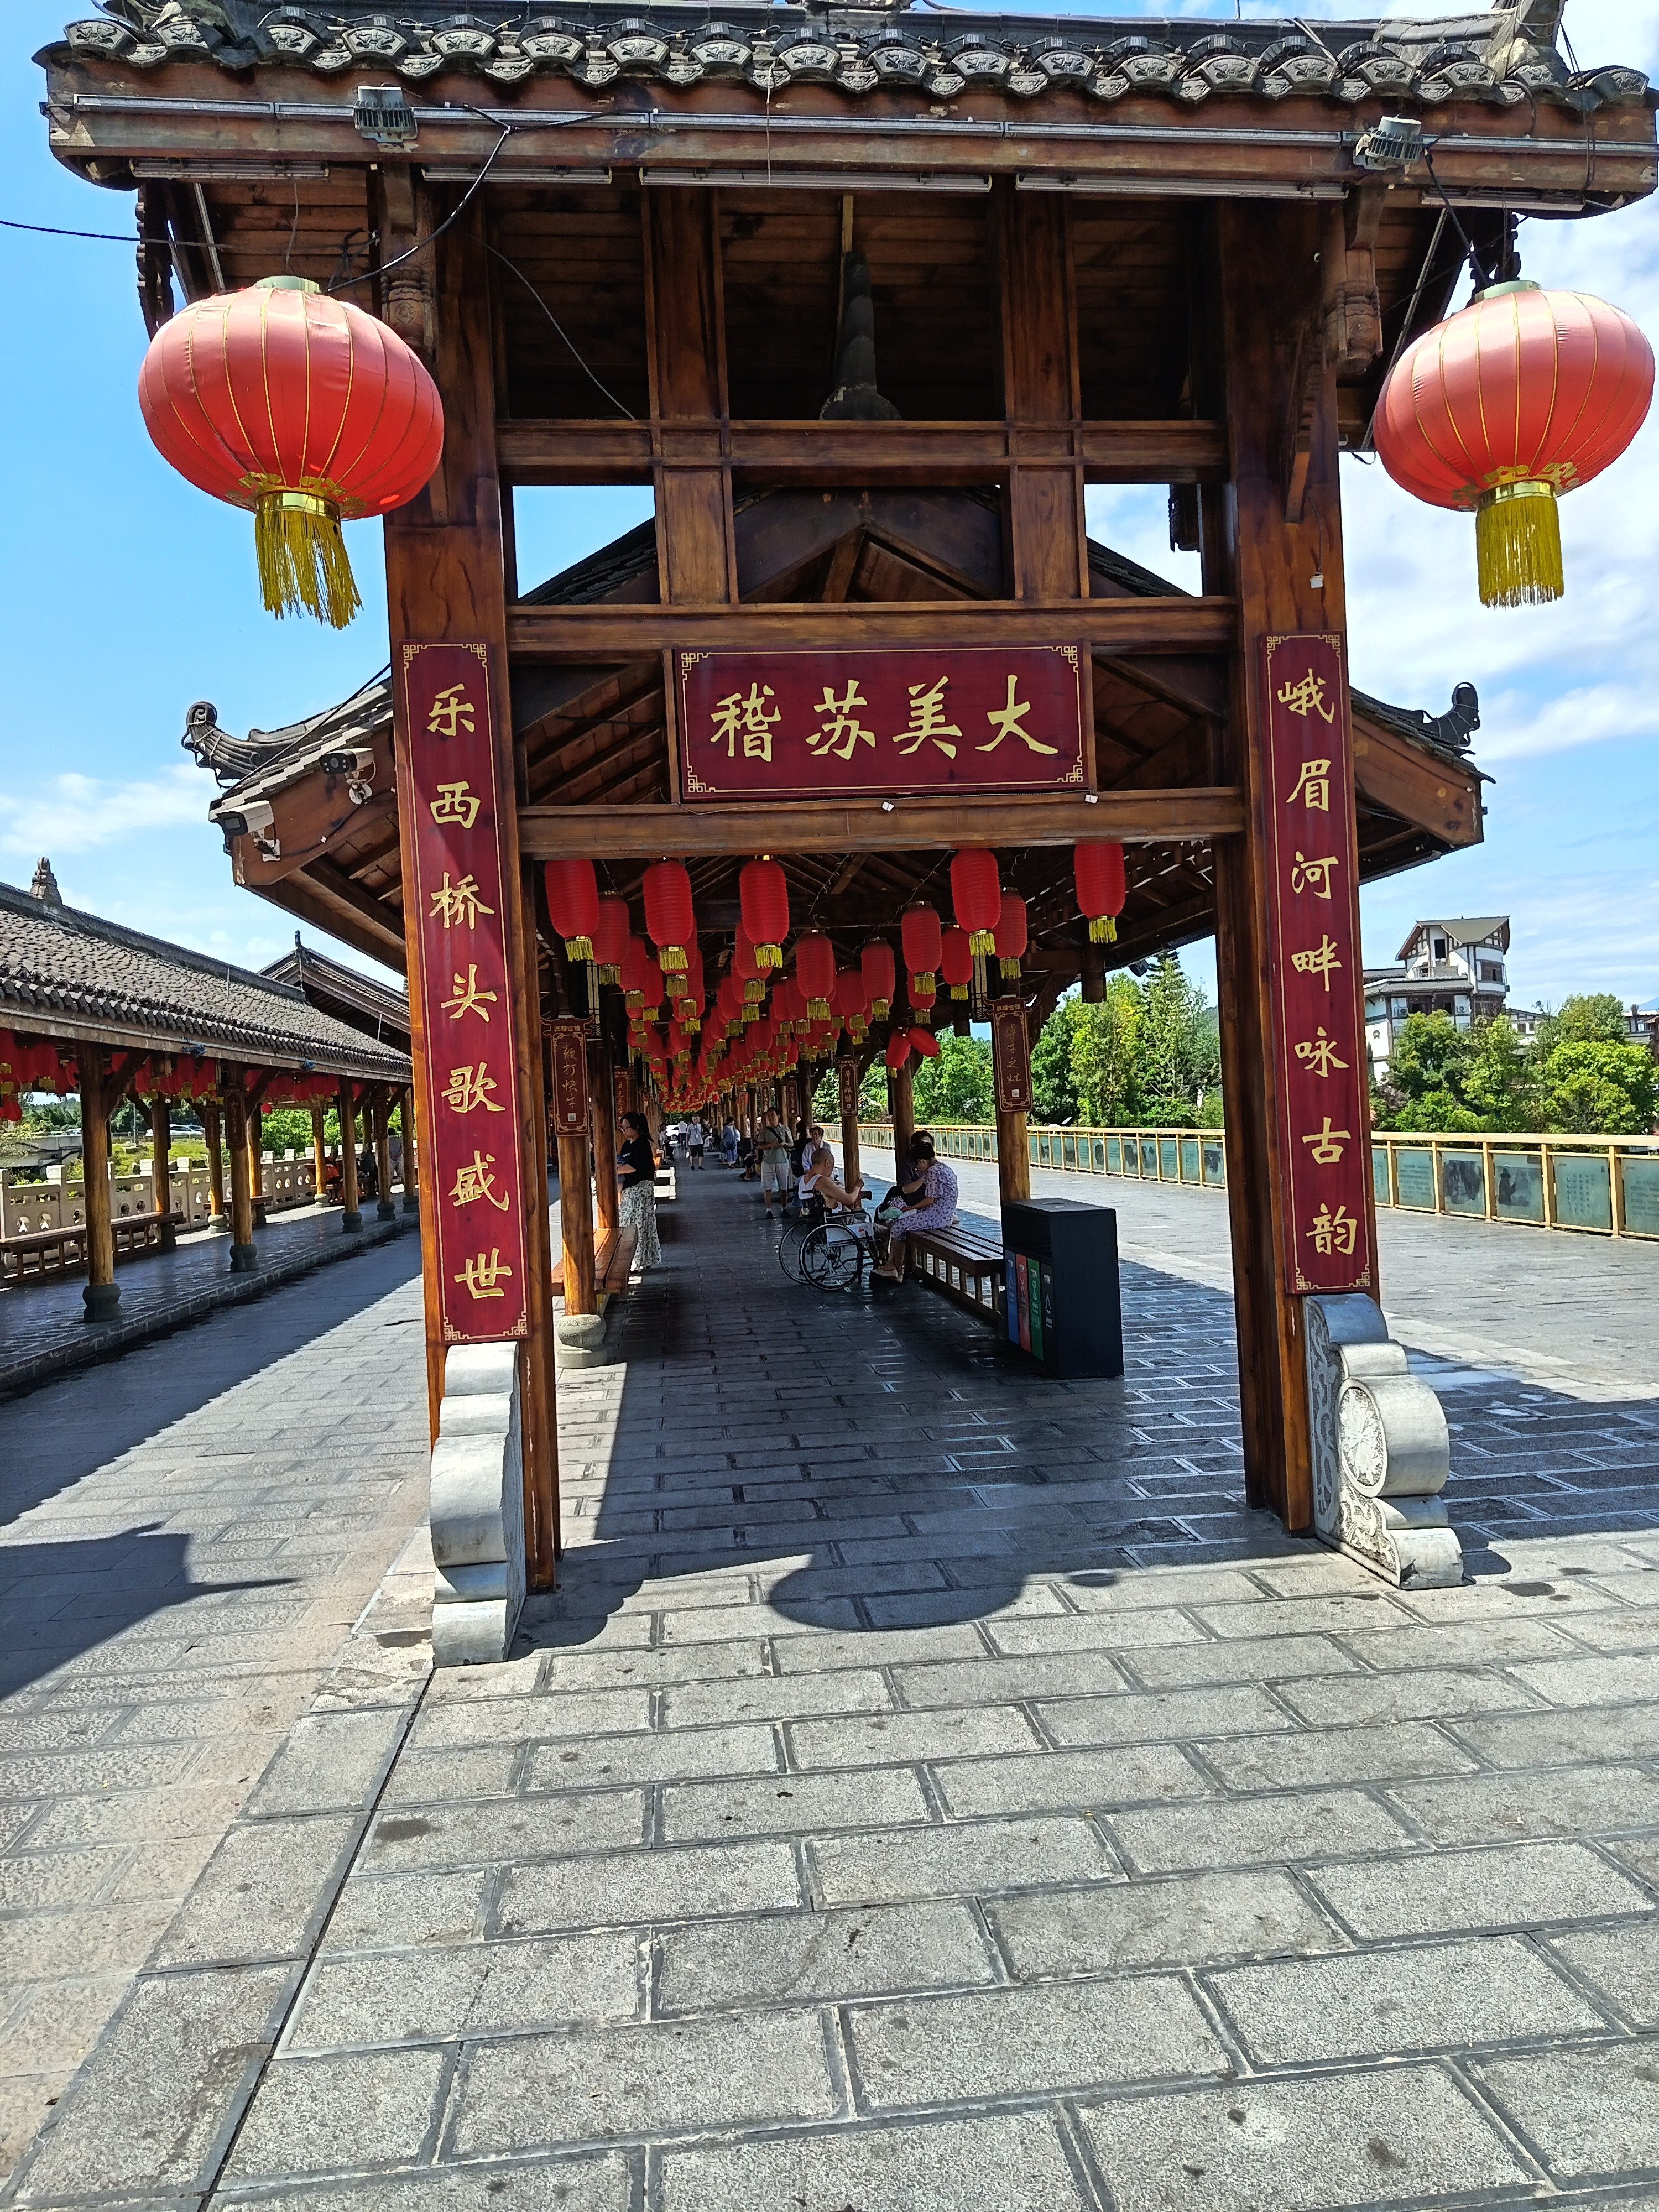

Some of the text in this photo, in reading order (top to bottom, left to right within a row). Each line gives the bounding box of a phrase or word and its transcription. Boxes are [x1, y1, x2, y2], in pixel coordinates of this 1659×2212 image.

[427, 682, 513, 1300] 乐西桥头歌盛世
[1277, 667, 1358, 1256] 峨眉河畔咏古韵
